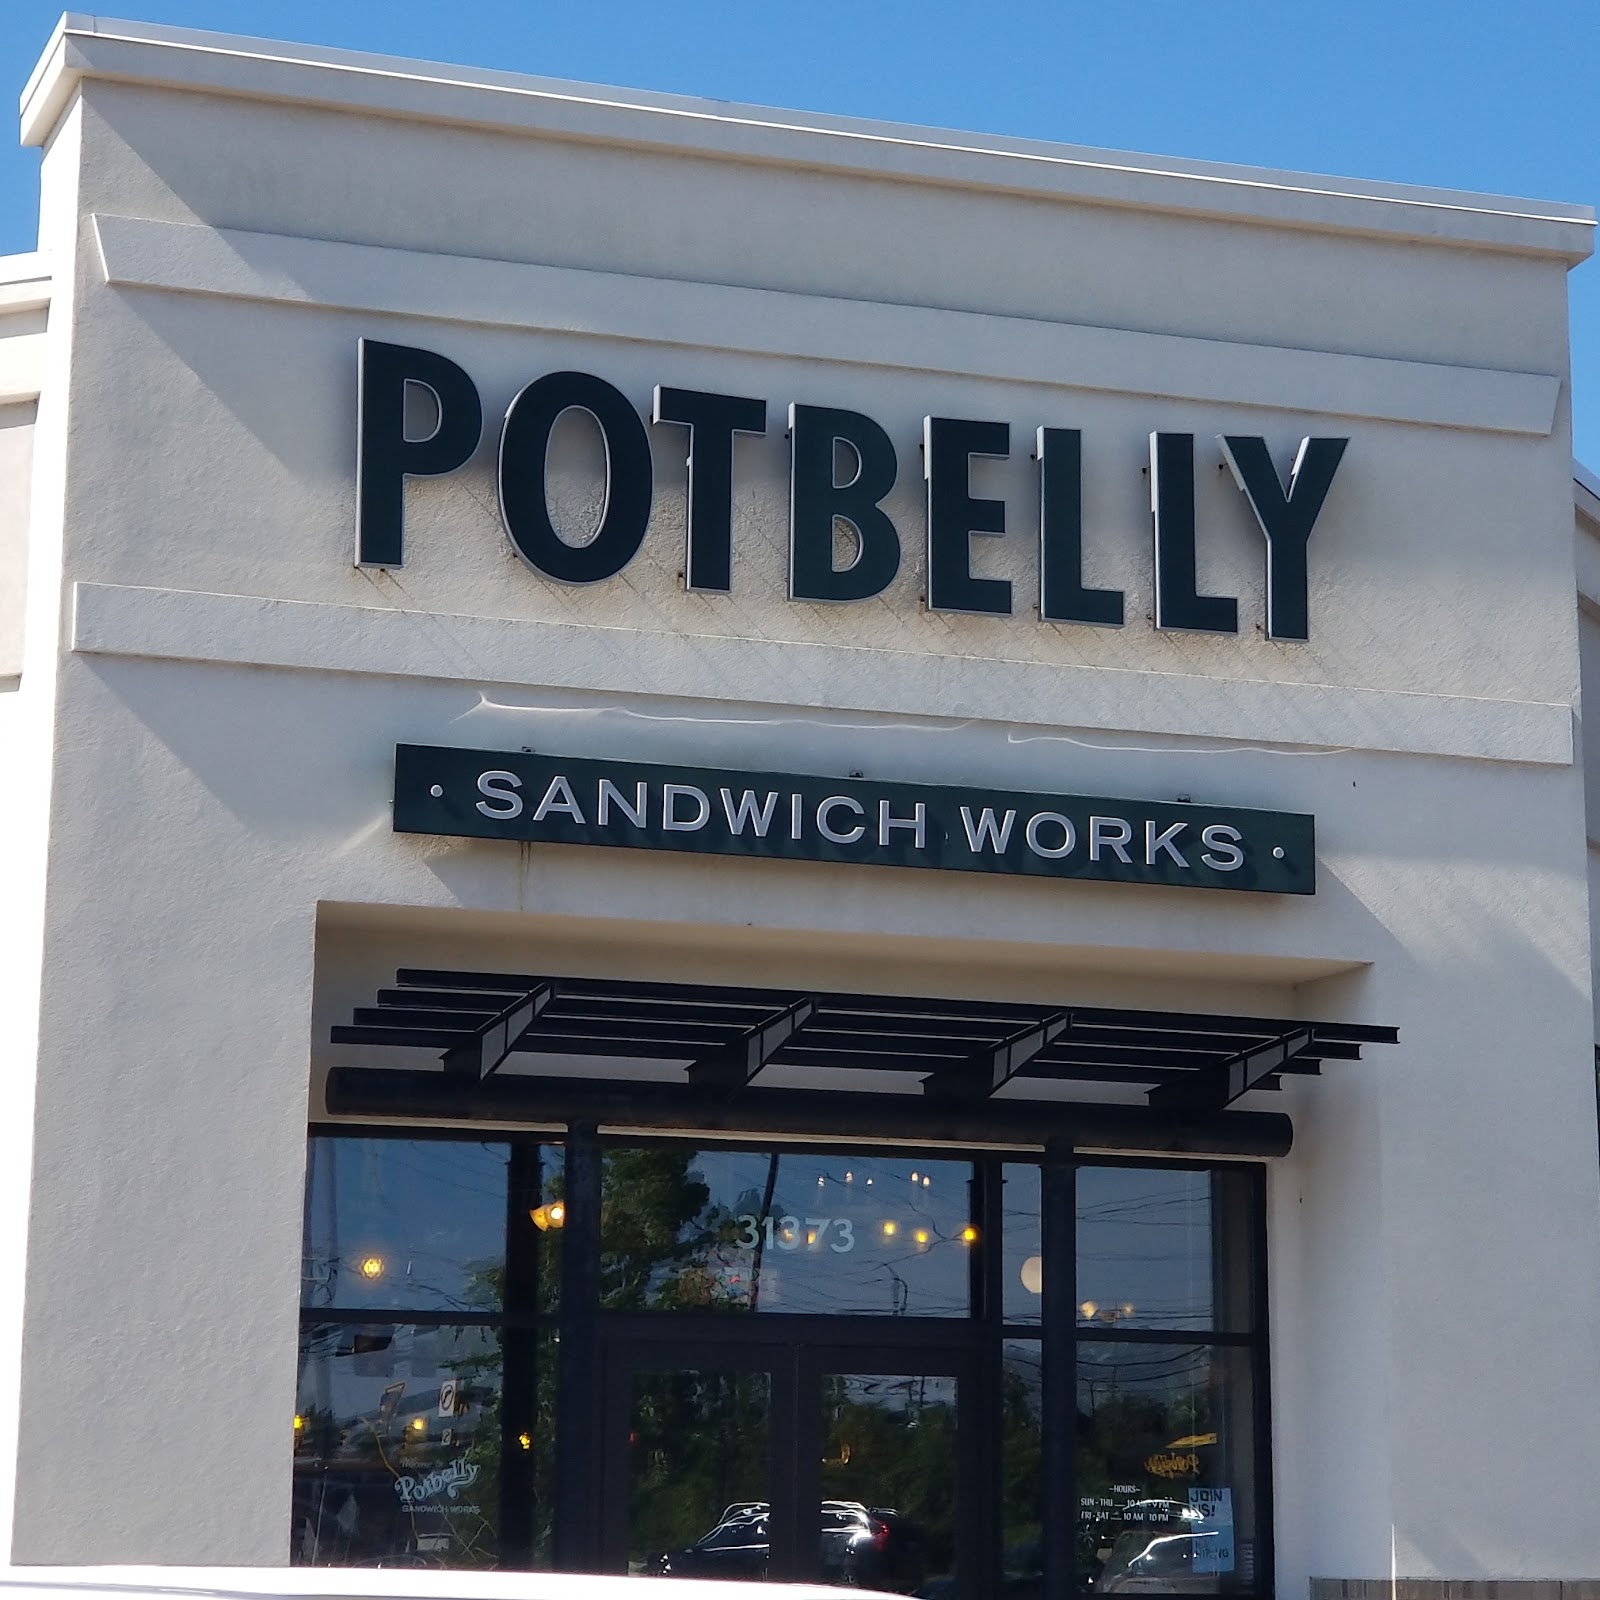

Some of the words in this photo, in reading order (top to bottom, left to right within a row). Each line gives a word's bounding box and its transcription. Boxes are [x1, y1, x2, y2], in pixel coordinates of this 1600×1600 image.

[353, 337, 1350, 642] POTBELLY
[475, 769, 926, 850] SANDWICH
[960, 806, 1244, 872] WORKS
[735, 1214, 855, 1253] 31373
[394, 1457, 480, 1503] Potbelly
[401, 1505, 448, 1513] SANDWICH
[450, 1505, 480, 1513] WORKS
[1080, 1497, 1095, 1507] SUN
[1099, 1498, 1113, 1507] THU
[1190, 1489, 1223, 1503] JOIN
[1096, 1511, 1110, 1520] SAT
[1123, 1512, 1132, 1520] 10
[1132, 1512, 1144, 1521] AM
[1158, 1513, 1169, 1522] PM
